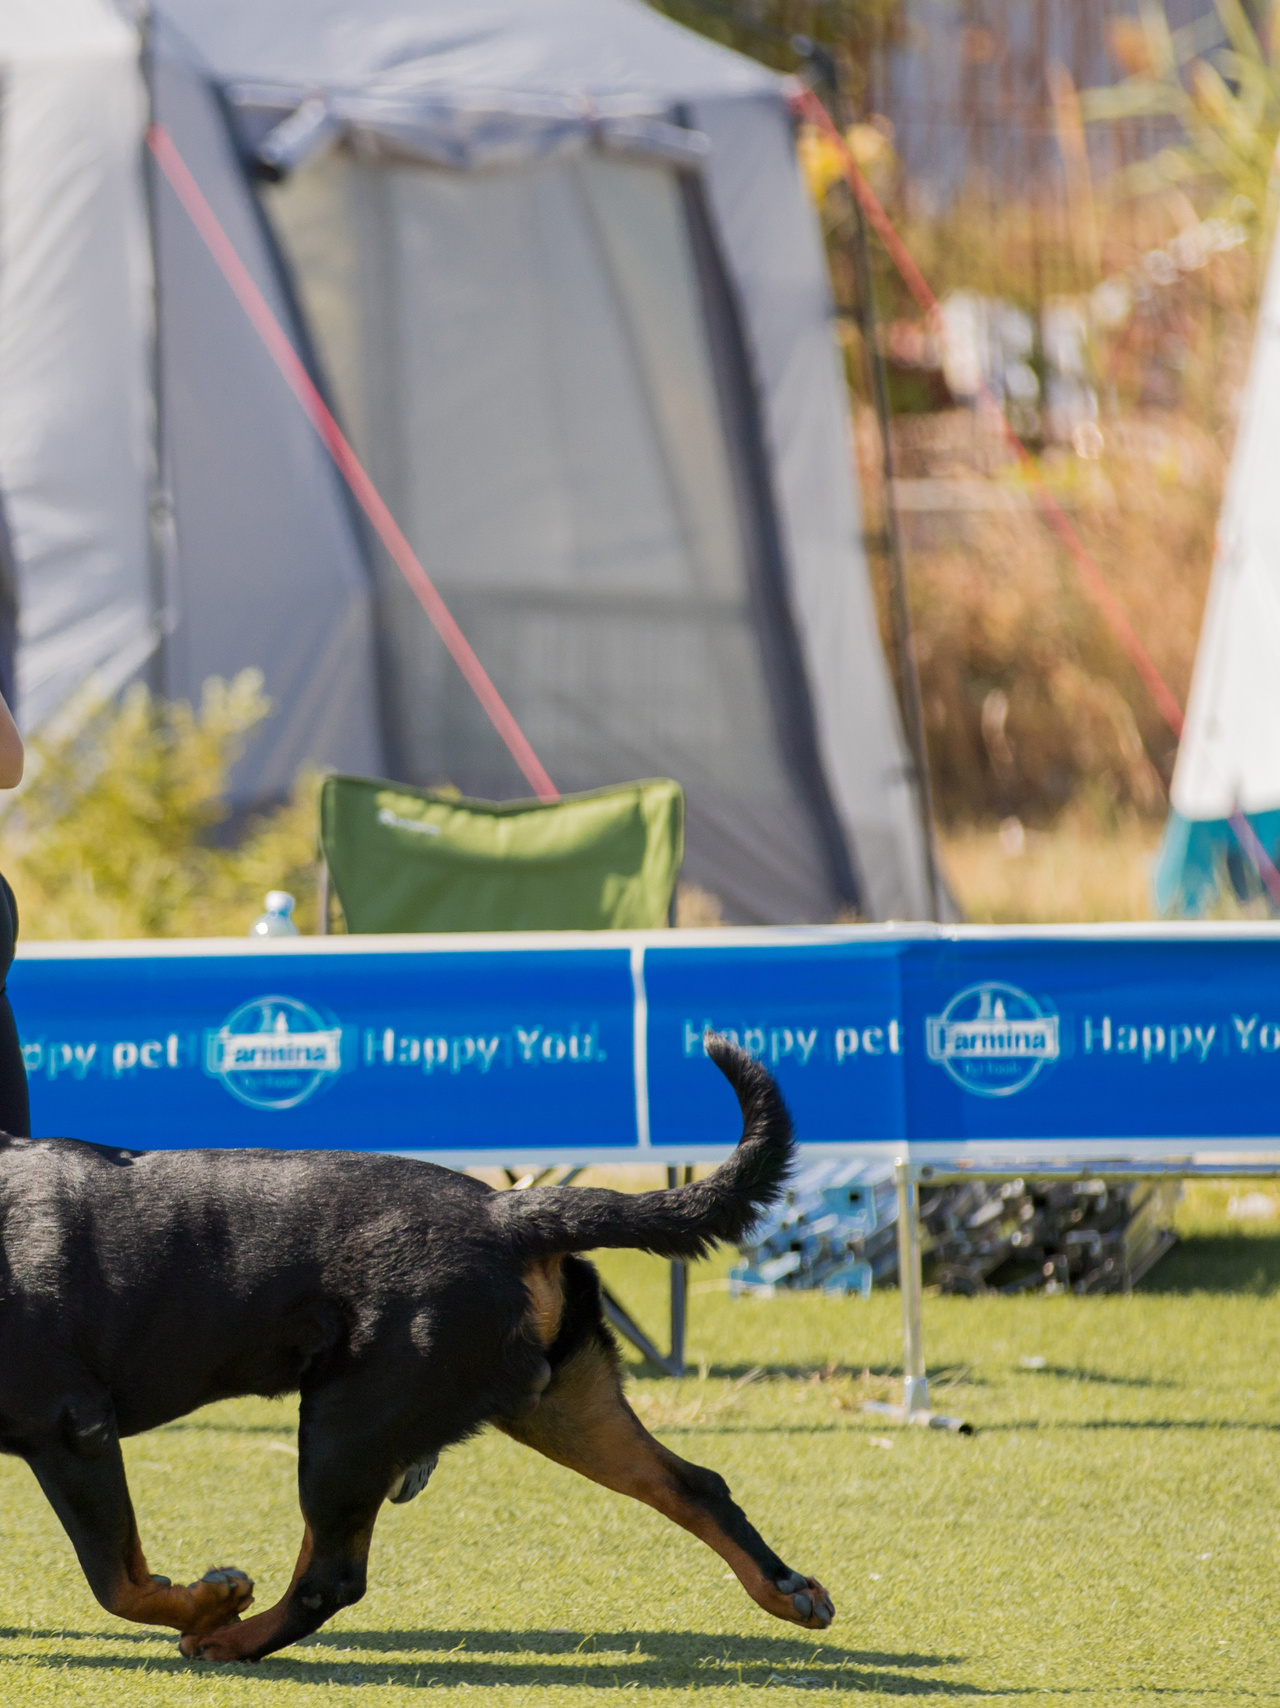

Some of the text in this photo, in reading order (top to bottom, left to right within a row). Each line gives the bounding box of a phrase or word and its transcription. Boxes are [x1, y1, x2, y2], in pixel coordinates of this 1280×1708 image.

[22, 1042, 97, 1080] ppy
[364, 1026, 500, 1075] Happy
[939, 1027, 1046, 1051] Farmina
[1084, 1015, 1216, 1064] Happy
